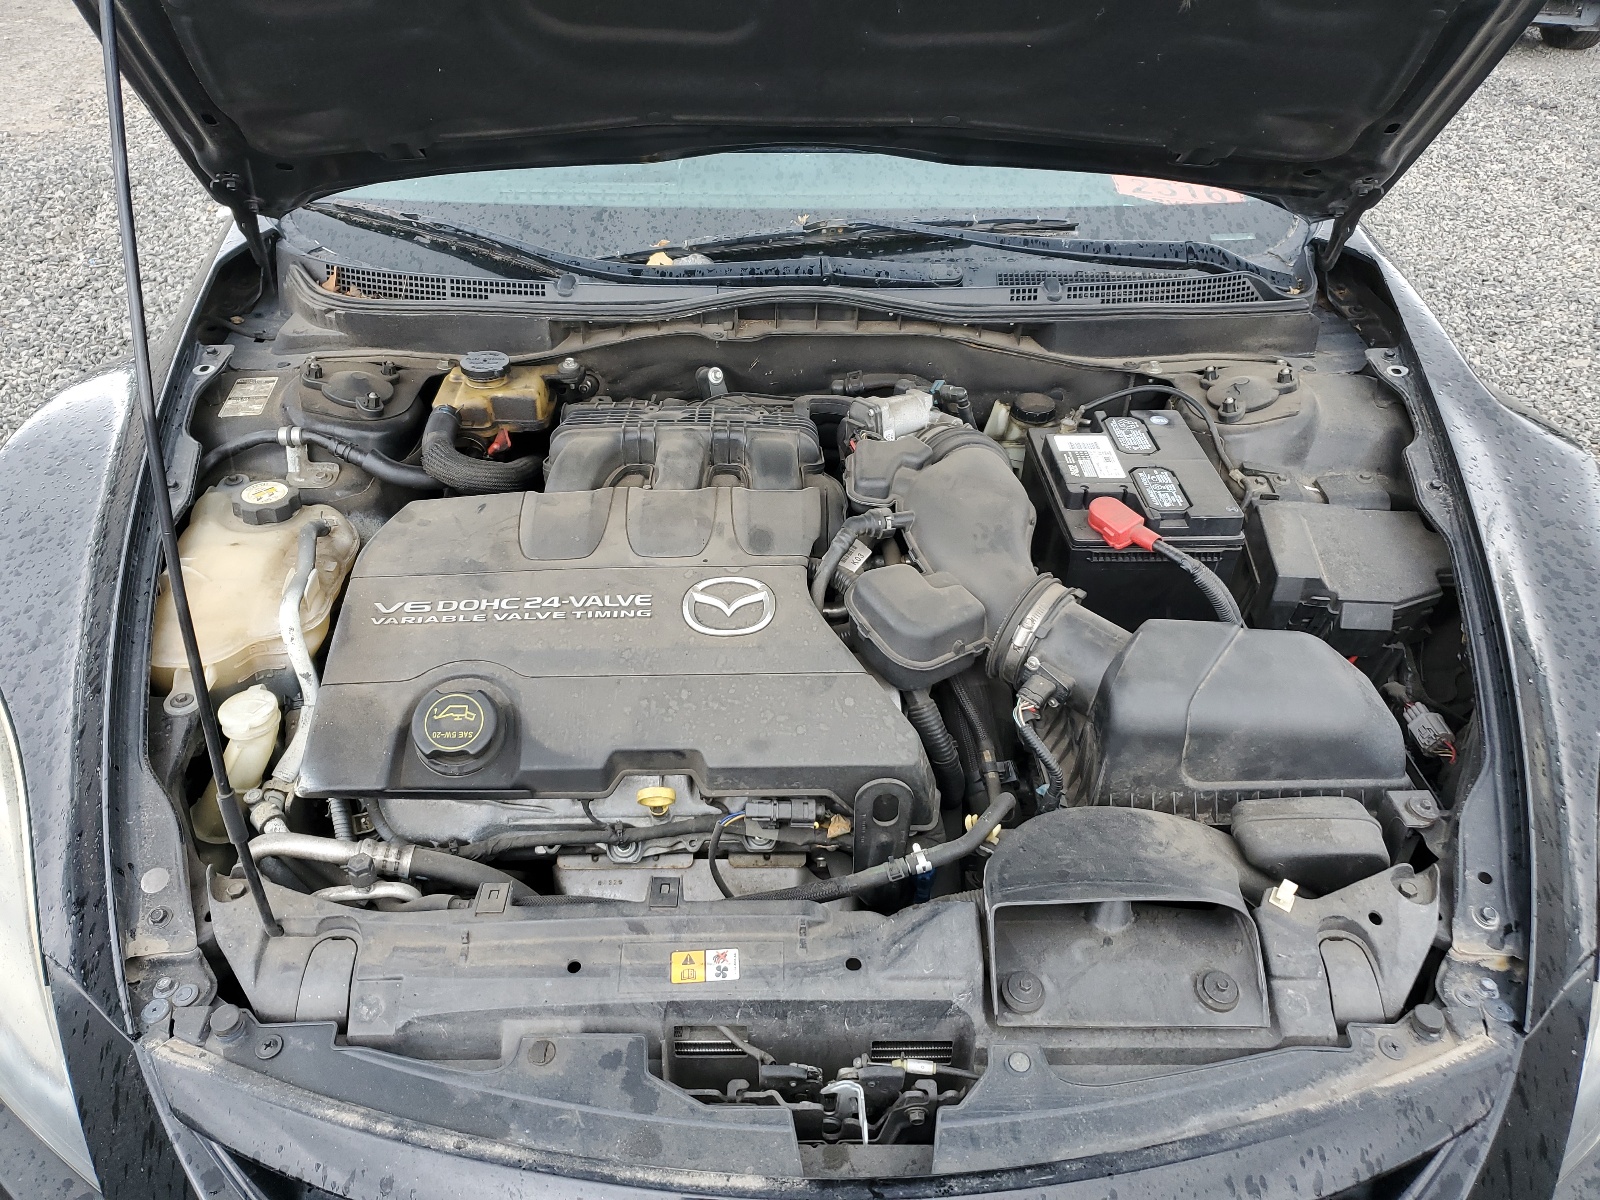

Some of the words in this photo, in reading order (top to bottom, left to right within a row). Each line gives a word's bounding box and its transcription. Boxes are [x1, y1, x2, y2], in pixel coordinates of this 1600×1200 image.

[851, 552, 865, 566] K03
[373, 600, 432, 614] V6
[436, 597, 521, 611] DOHC
[523, 594, 653, 609] 24-VALVE
[371, 613, 486, 626] VARIABLE
[495, 611, 566, 621] VALVE
[572, 609, 652, 619] TIMING
[458, 731, 474, 739] SAE
